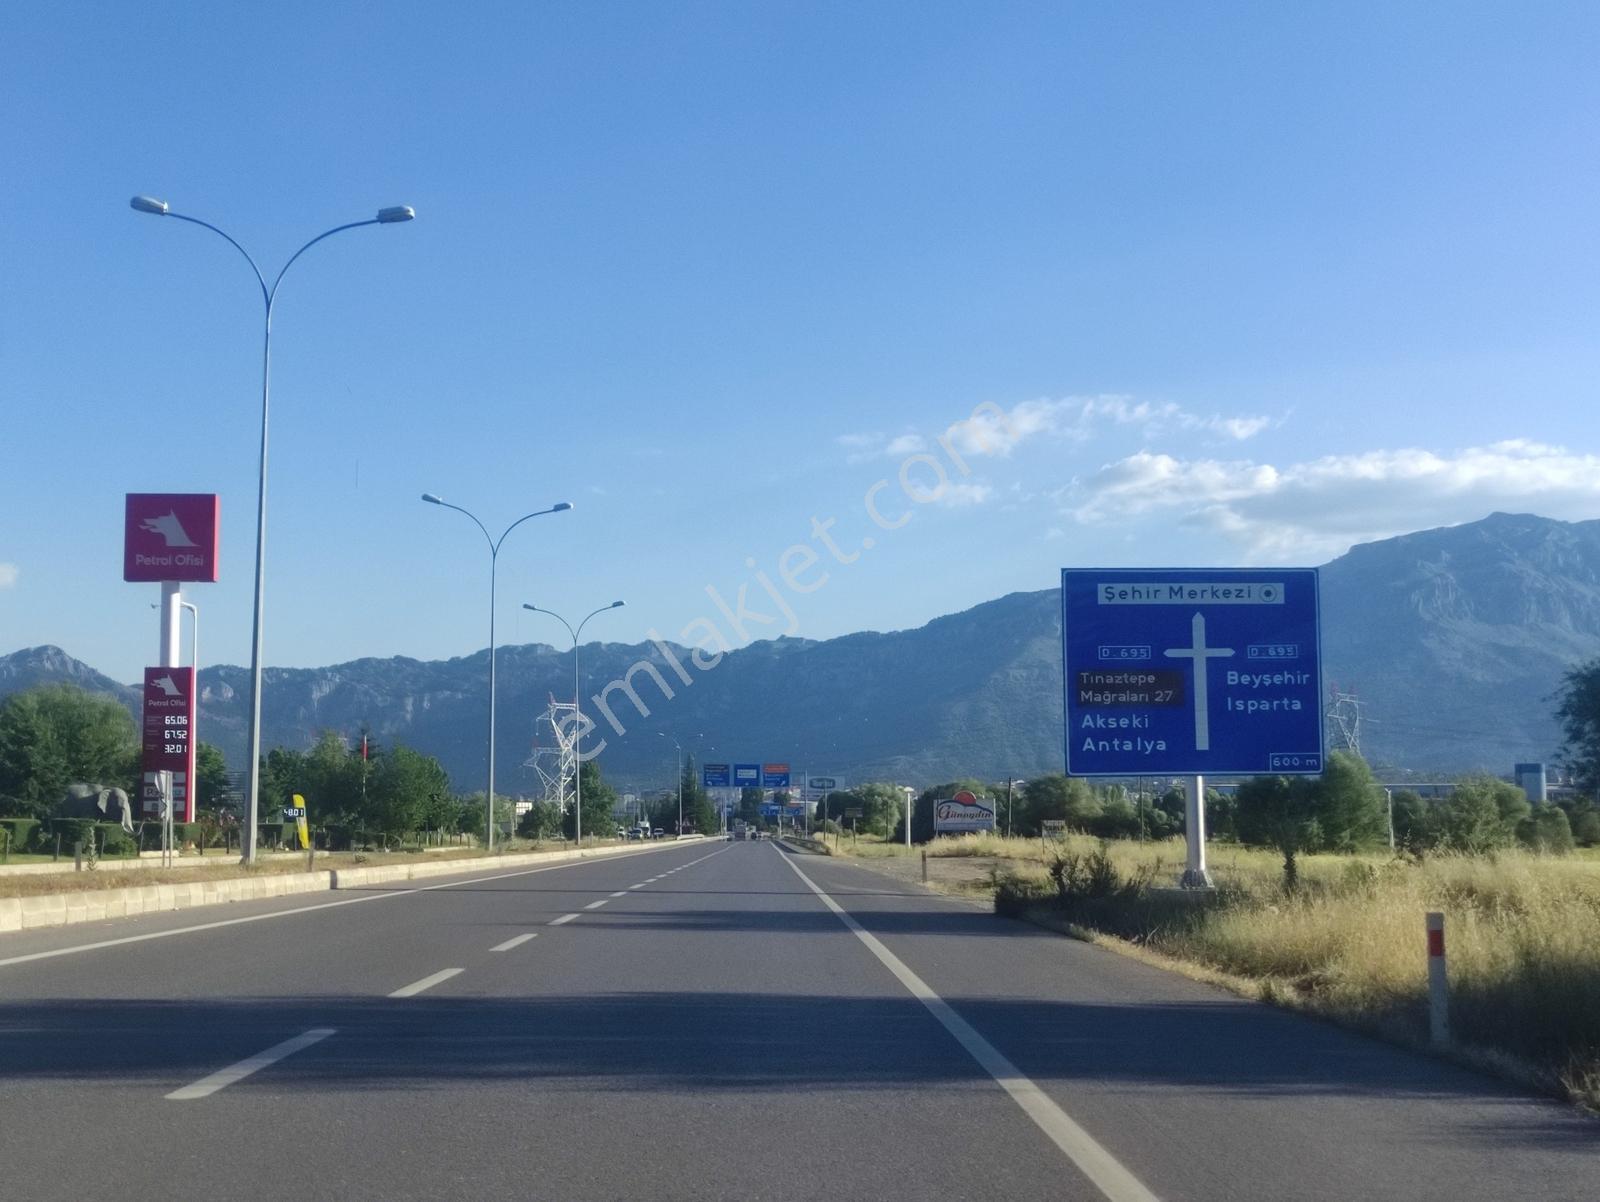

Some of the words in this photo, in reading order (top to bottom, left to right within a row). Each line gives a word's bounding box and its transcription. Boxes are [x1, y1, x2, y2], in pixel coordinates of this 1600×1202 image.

[135, 554, 172, 567] Petrol
[174, 554, 204, 567] Ofisi
[1104, 585, 1161, 602] Şehir
[1168, 585, 1251, 600] Merkezi
[1226, 671, 1311, 688] Beyşehir
[1080, 690, 1150, 704] Mağraları
[1154, 690, 1174, 702] 27
[1227, 697, 1302, 714] Isparta
[1081, 714, 1150, 729] Akseki
[1082, 737, 1167, 754] Antalya
[1273, 756, 1300, 767] 600
[1305, 758, 1318, 766] m
